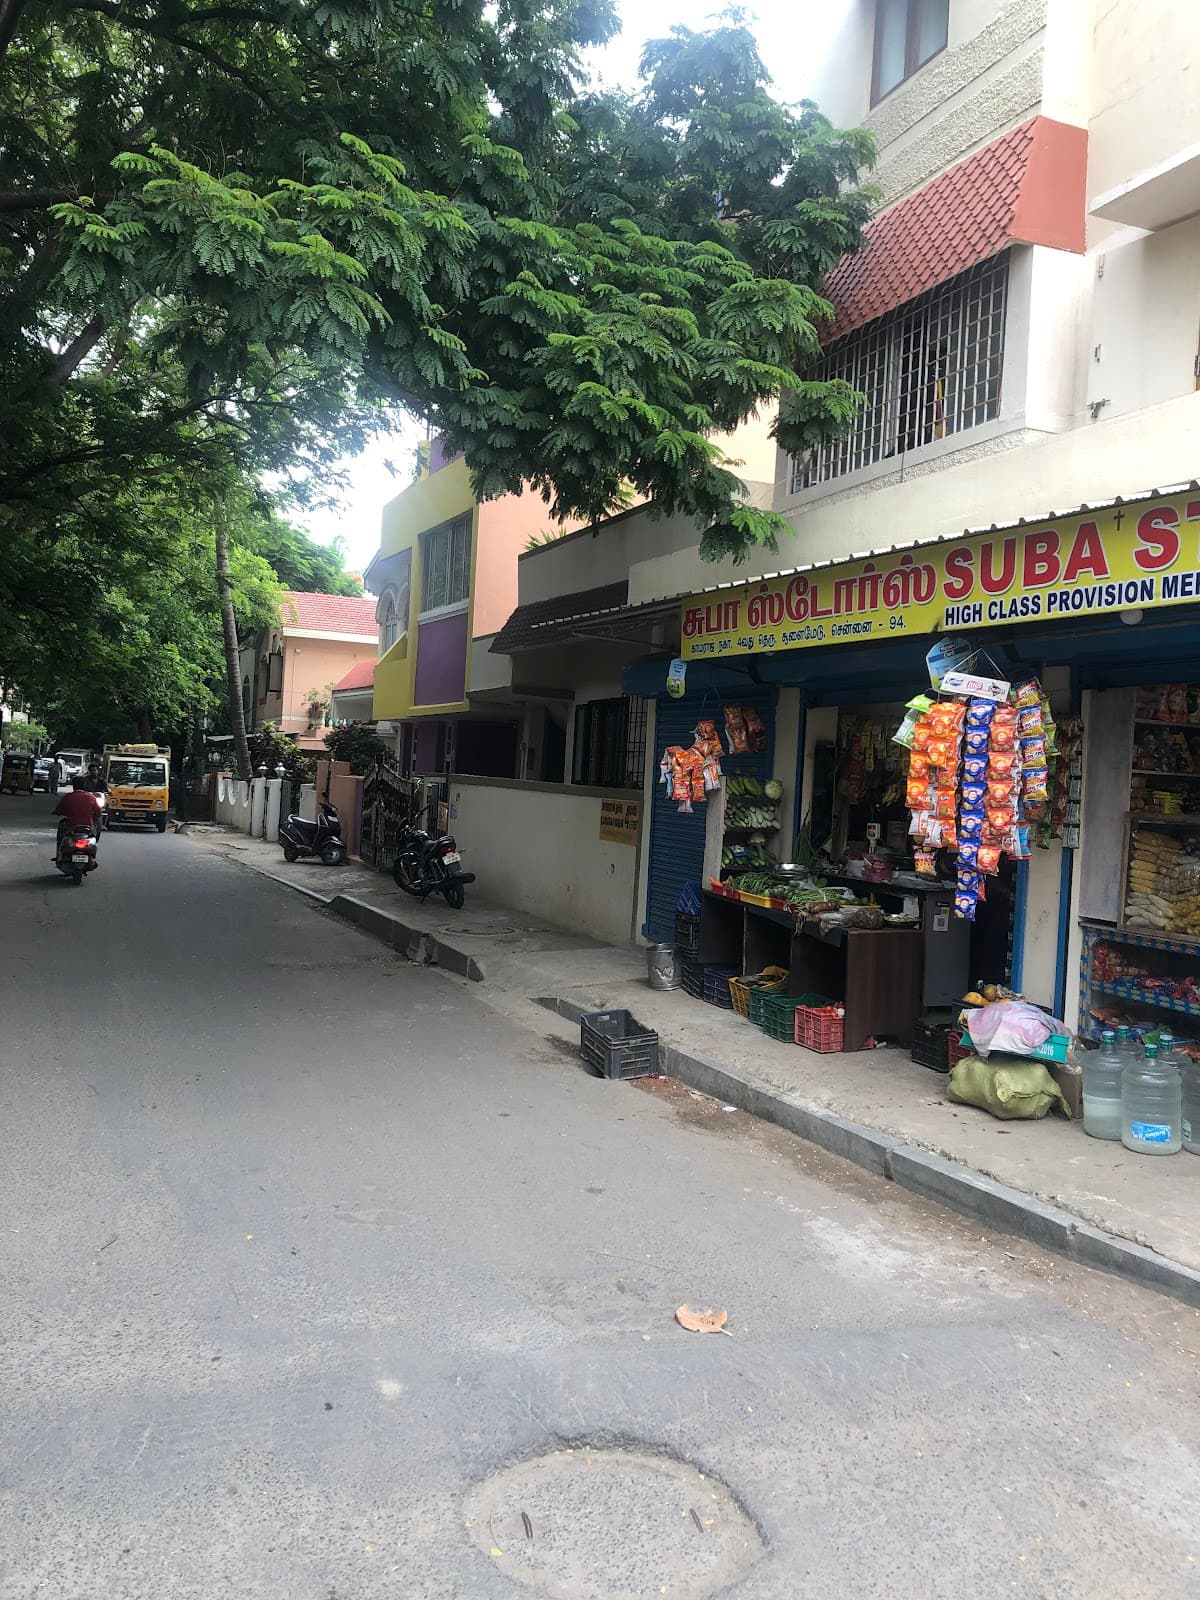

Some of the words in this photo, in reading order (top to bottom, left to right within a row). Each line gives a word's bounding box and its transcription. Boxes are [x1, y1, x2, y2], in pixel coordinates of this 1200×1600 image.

[682, 600, 741, 639] சுபா
[748, 553, 937, 629] ஸ்டோர்ஸ்
[943, 521, 1110, 602] SUBA
[945, 603, 983, 627] HIGH
[988, 594, 1041, 620] CLASS
[1047, 578, 1154, 613] PROVISION
